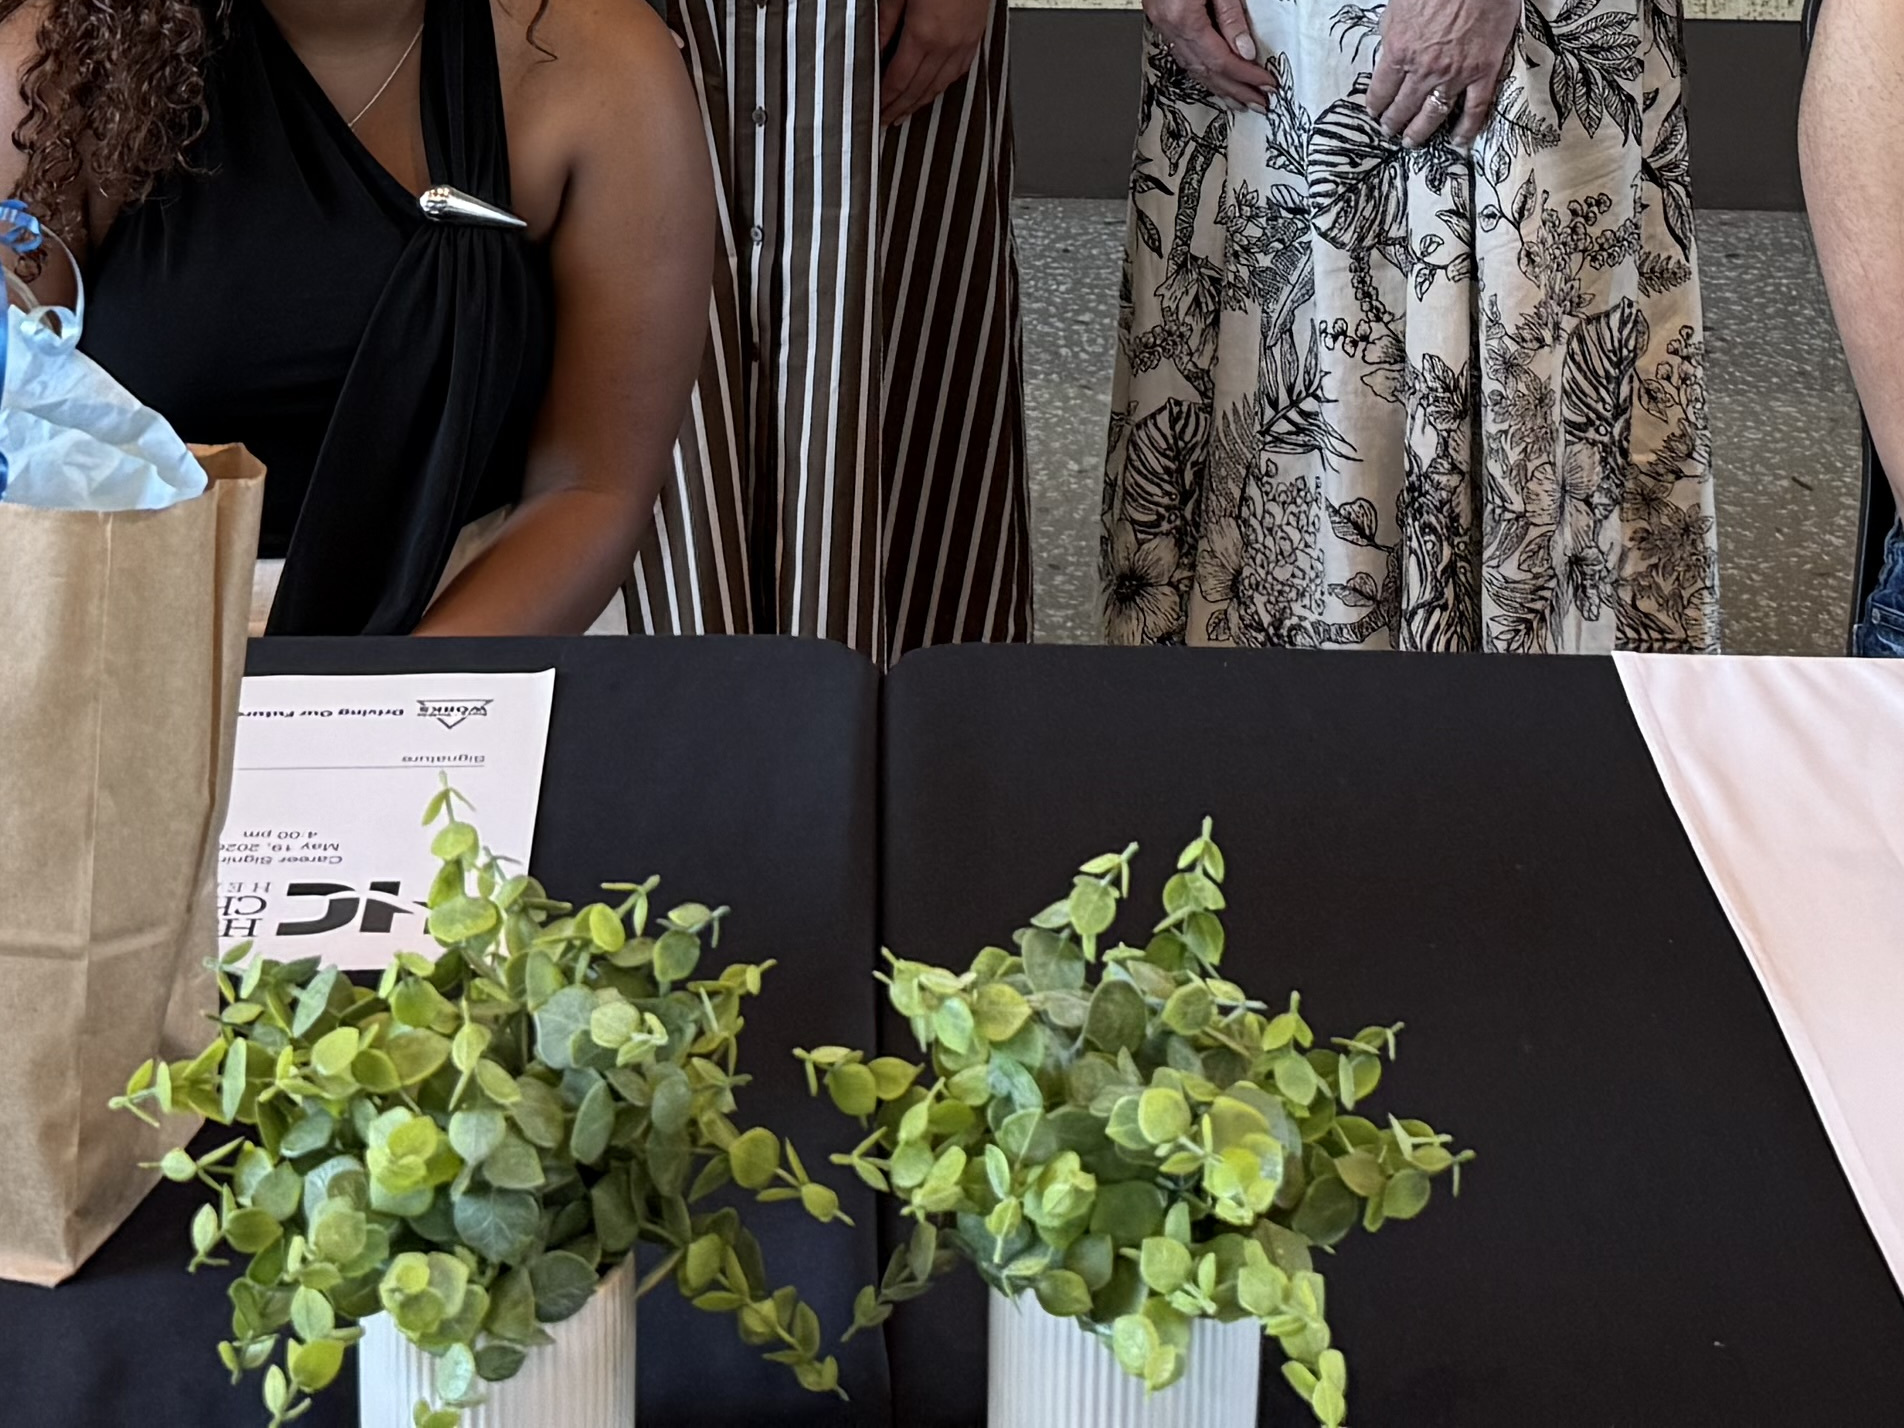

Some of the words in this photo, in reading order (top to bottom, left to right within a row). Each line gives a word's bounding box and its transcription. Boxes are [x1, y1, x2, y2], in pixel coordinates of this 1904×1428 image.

[338, 708, 404, 718] Driving
[401, 754, 485, 763] Signature
[243, 829, 273, 838] pm
[277, 830, 318, 840] 4:00
[300, 842, 340, 852] May
[278, 855, 343, 865] Career
